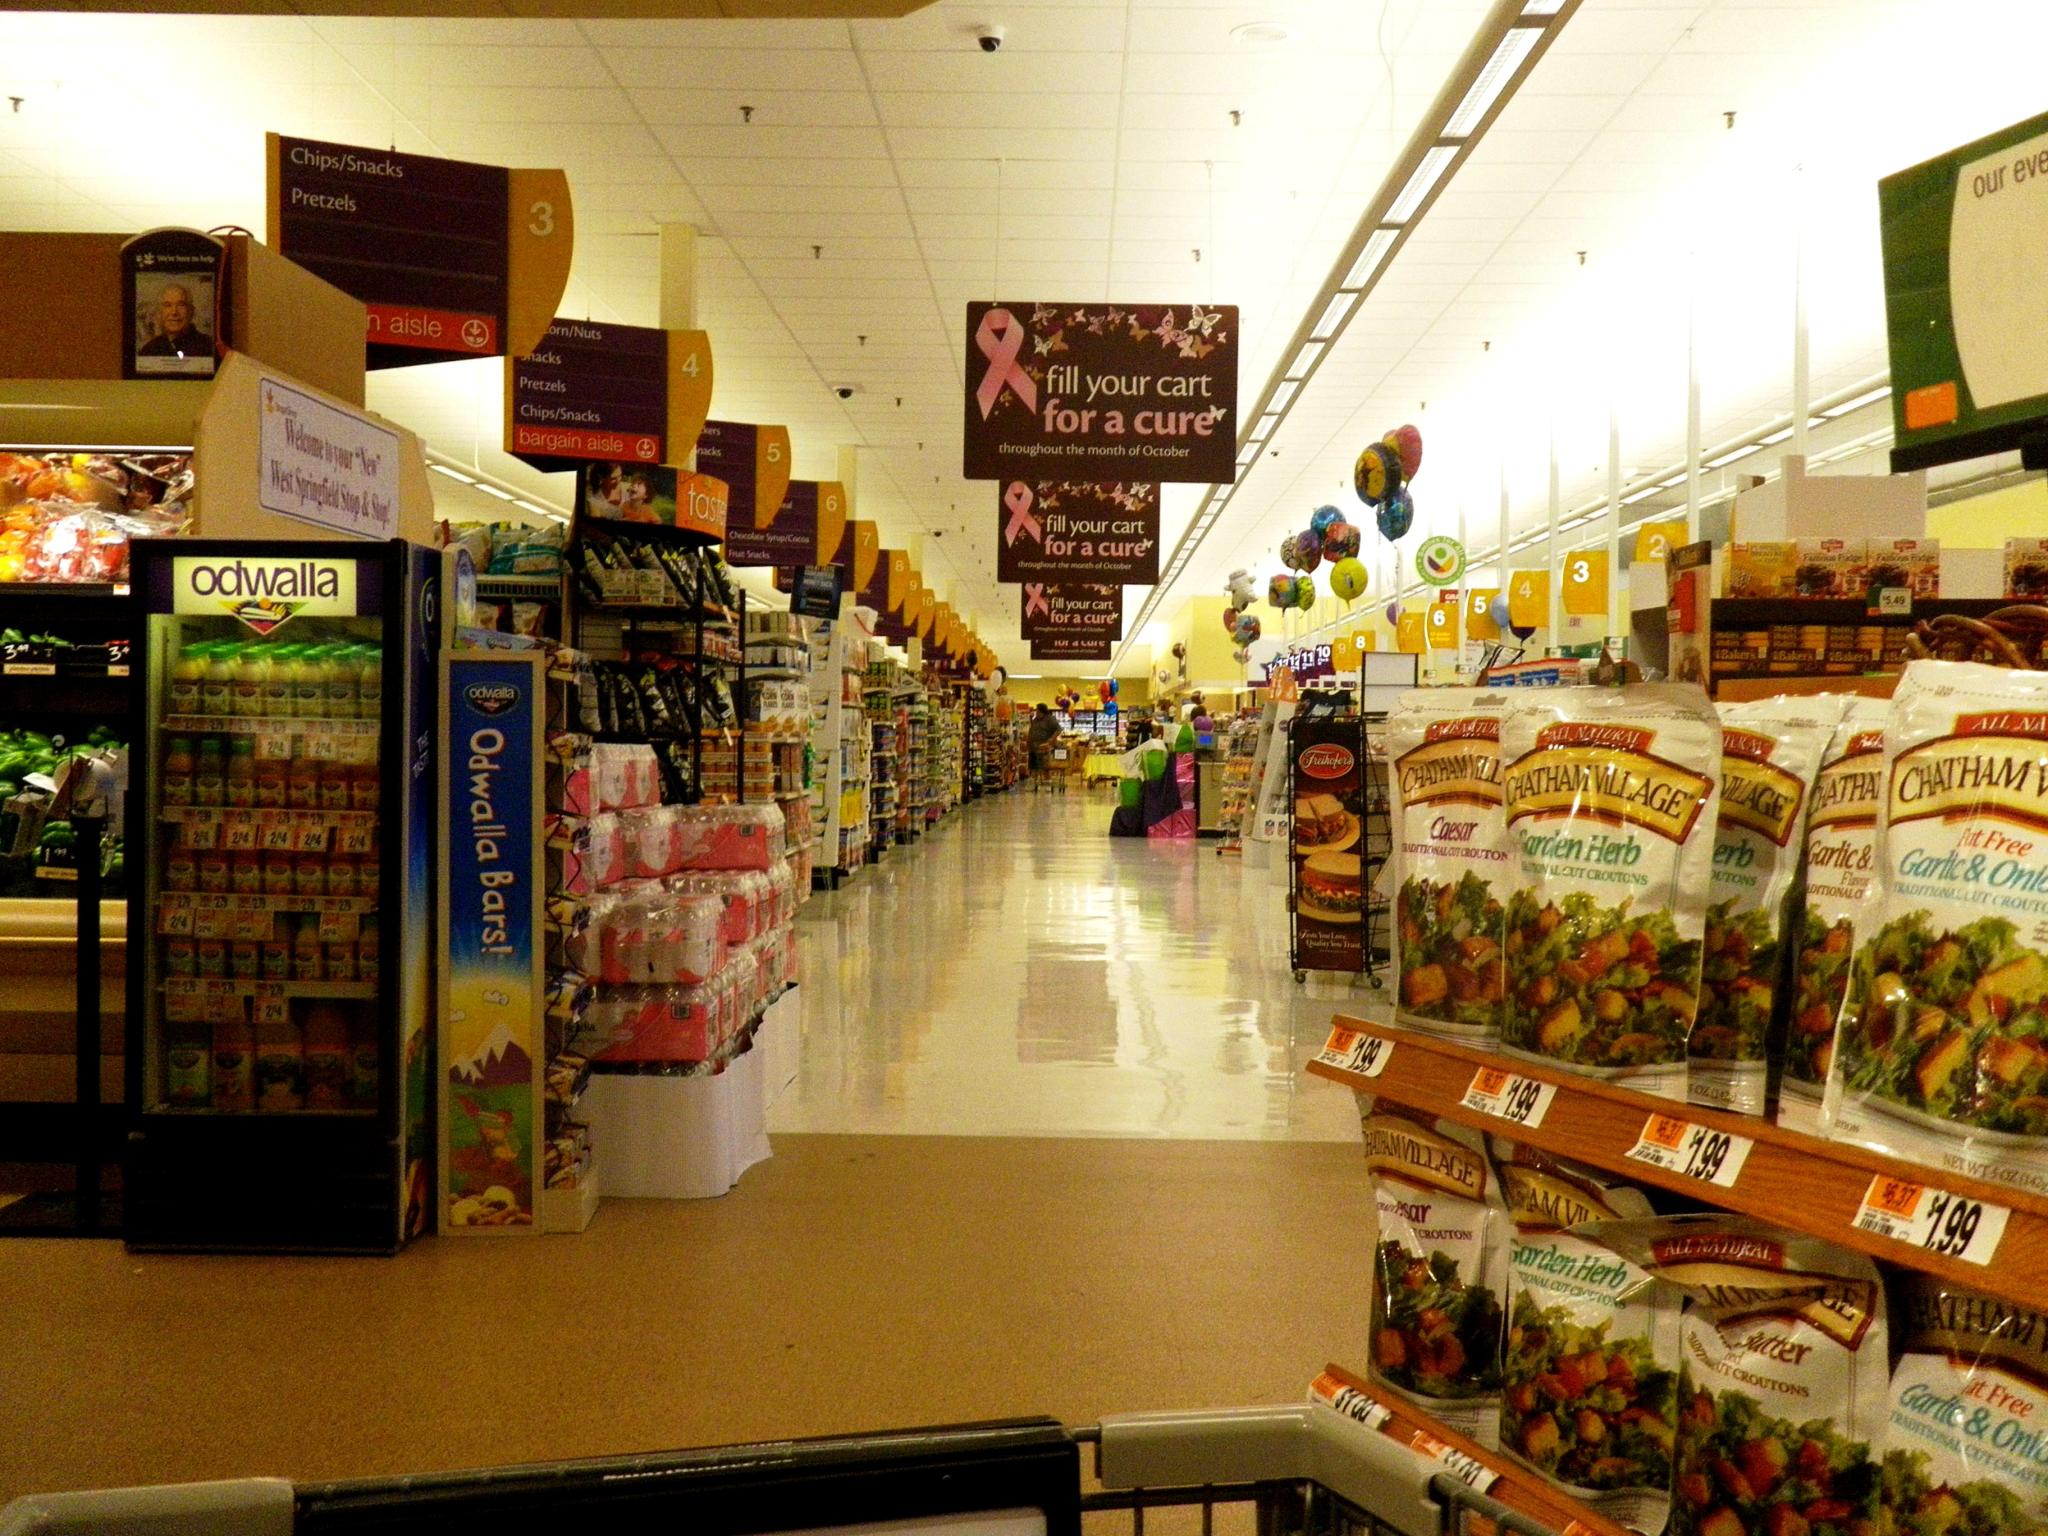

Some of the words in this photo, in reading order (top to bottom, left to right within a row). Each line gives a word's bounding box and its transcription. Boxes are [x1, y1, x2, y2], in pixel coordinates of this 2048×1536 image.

[291, 147, 403, 178] Chips/Snacks
[1973, 165, 2007, 198] our
[292, 188, 356, 212] Pretzels
[529, 201, 554, 236] 3
[390, 314, 442, 337] aisle
[682, 353, 698, 377] 4
[520, 377, 566, 393] Pretzels
[1046, 365, 1078, 394] fill
[1086, 374, 1151, 402] your
[1156, 374, 1212, 397] cart
[520, 404, 600, 423] Chips/Snacks
[1043, 399, 1096, 433] for
[1104, 410, 1124, 434] a
[1134, 410, 1214, 435] cure
[519, 430, 581, 452] bargain
[587, 435, 623, 453] aisle
[767, 443, 780, 462] 5
[999, 443, 1062, 456] throughout
[1066, 444, 1084, 455] the
[1088, 444, 1125, 456] month
[1129, 444, 1140, 456] of
[1142, 445, 1190, 457] October
[826, 496, 838, 512] 6
[1046, 514, 1066, 532] fill
[1070, 521, 1106, 537] your
[1112, 521, 1144, 534] cart
[863, 533, 872, 546] 7
[1044, 535, 1076, 556] for
[1081, 542, 1093, 556] a
[1100, 541, 1146, 556] cure
[1651, 534, 1665, 558] 2
[896, 560, 904, 572] 8
[1572, 560, 1589, 582] 3
[191, 560, 339, 598] odwalla
[910, 580, 917, 590] 9
[1520, 580, 1532, 598] 4
[922, 597, 934, 606] 10
[1052, 597, 1064, 609] fill
[1066, 601, 1090, 612] your
[1092, 600, 1114, 610] cart
[1474, 596, 1487, 614] 5
[1050, 610, 1068, 623] for
[1073, 614, 1082, 623] a
[1084, 612, 1114, 624] cure
[1405, 620, 1414, 632] 7
[1433, 610, 1446, 626] 6
[1317, 646, 1330, 658] 10
[1339, 644, 1346, 654] 9
[1356, 636, 1366, 648] 8
[1302, 652, 1314, 664] 11
[470, 686, 514, 699] odwalla
[1972, 714, 2010, 732] ALL
[1900, 755, 2032, 803] CHATHAM
[468, 728, 507, 864] Odwalla
[1506, 764, 1590, 806] CHATHAM
[1594, 762, 1687, 820] VILLAGE
[1430, 816, 1478, 842] Caesar
[1584, 835, 1642, 866] Herb
[1714, 839, 1754, 869] erb
[1984, 830, 2034, 857] Free
[1808, 840, 1854, 870] Garlic
[1856, 844, 1872, 871] &
[1900, 849, 1962, 881] Garlic
[1964, 854, 1984, 882] &
[1586, 868, 1649, 886] CROUTONS
[479, 871, 517, 954] Bars!
[1402, 1136, 1474, 1188] VILLAGE
[1664, 1238, 1692, 1257] ALL
[1576, 1255, 1628, 1289] Herb
[1915, 1294, 2036, 1346] HATHAM
[1733, 1368, 1810, 1398] CROUTONS
[1986, 1384, 2034, 1418] Free
[1964, 1407, 1990, 1440] &
